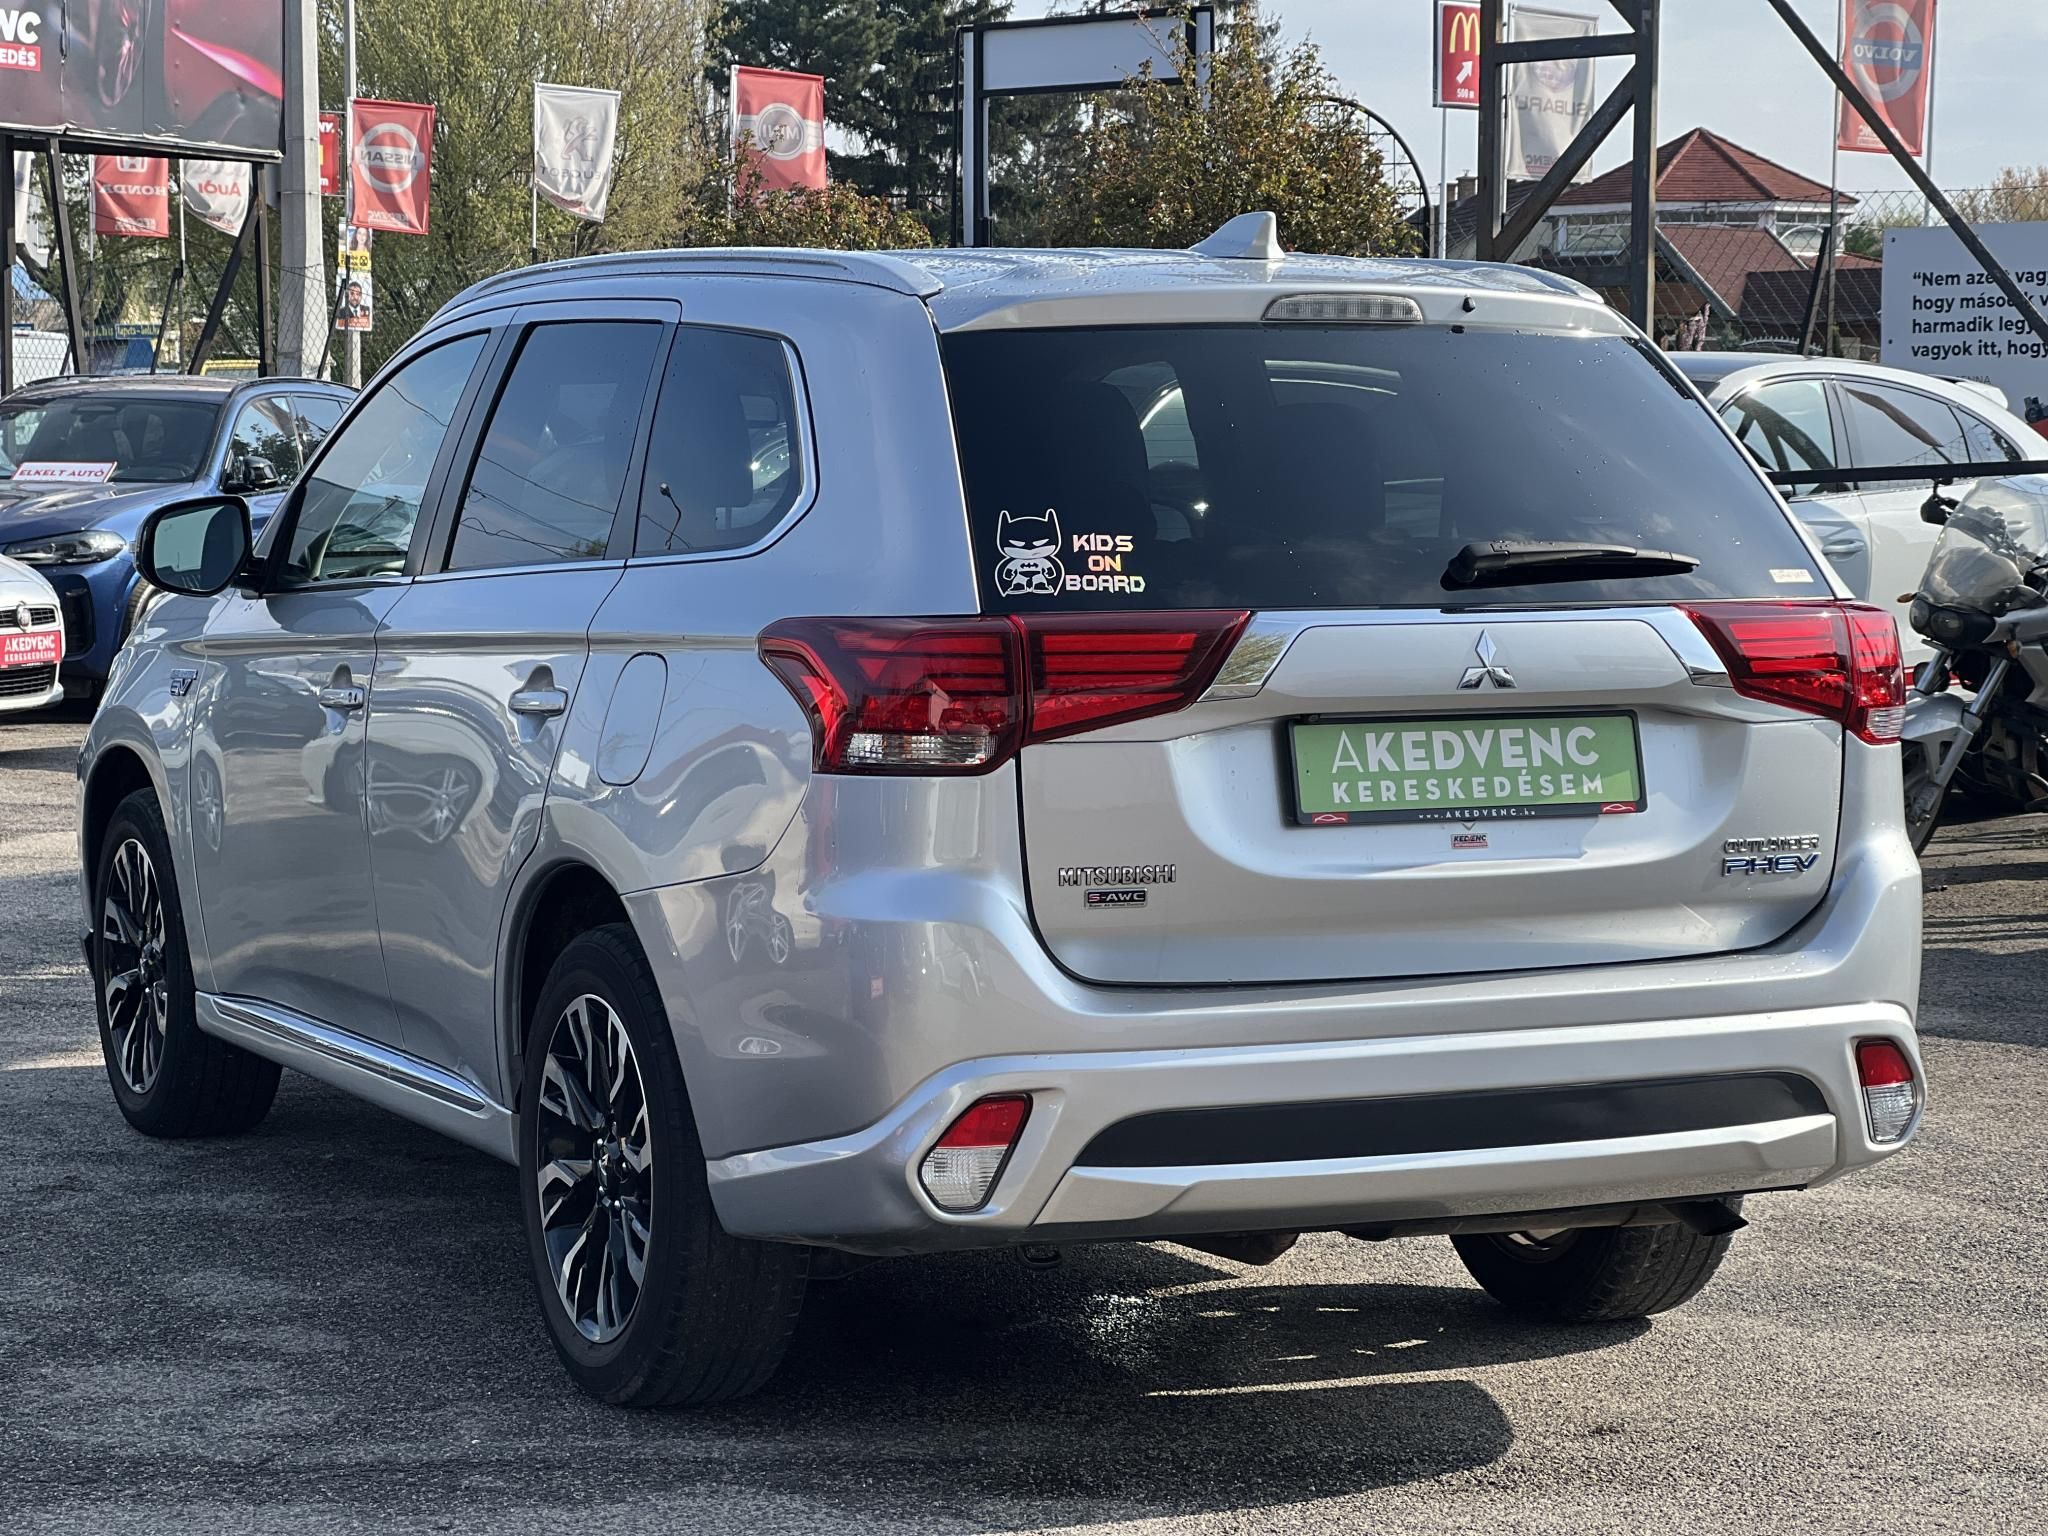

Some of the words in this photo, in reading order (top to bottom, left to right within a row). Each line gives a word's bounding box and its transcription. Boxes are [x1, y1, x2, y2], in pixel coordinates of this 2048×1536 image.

[2015, 270, 2048, 287] vag
[1912, 295, 1955, 313] hogy
[1912, 316, 1993, 334] harmadik
[1912, 341, 1973, 360] vagyok
[1978, 339, 2002, 358] itt,
[19, 469, 66, 477] ELKELT
[1072, 533, 1134, 553] KIDS
[1088, 554, 1122, 572] ON
[1065, 575, 1146, 594] BOARD
[4, 634, 56, 653] AKEDVENC
[1331, 726, 1600, 774] AKEDVENC
[1332, 769, 1604, 804] KERESKEDÉSEM
[1721, 852, 1822, 877] PHEV
[1058, 864, 1177, 887] MITSUBISHI
[1088, 892, 1145, 903] S-AWC
